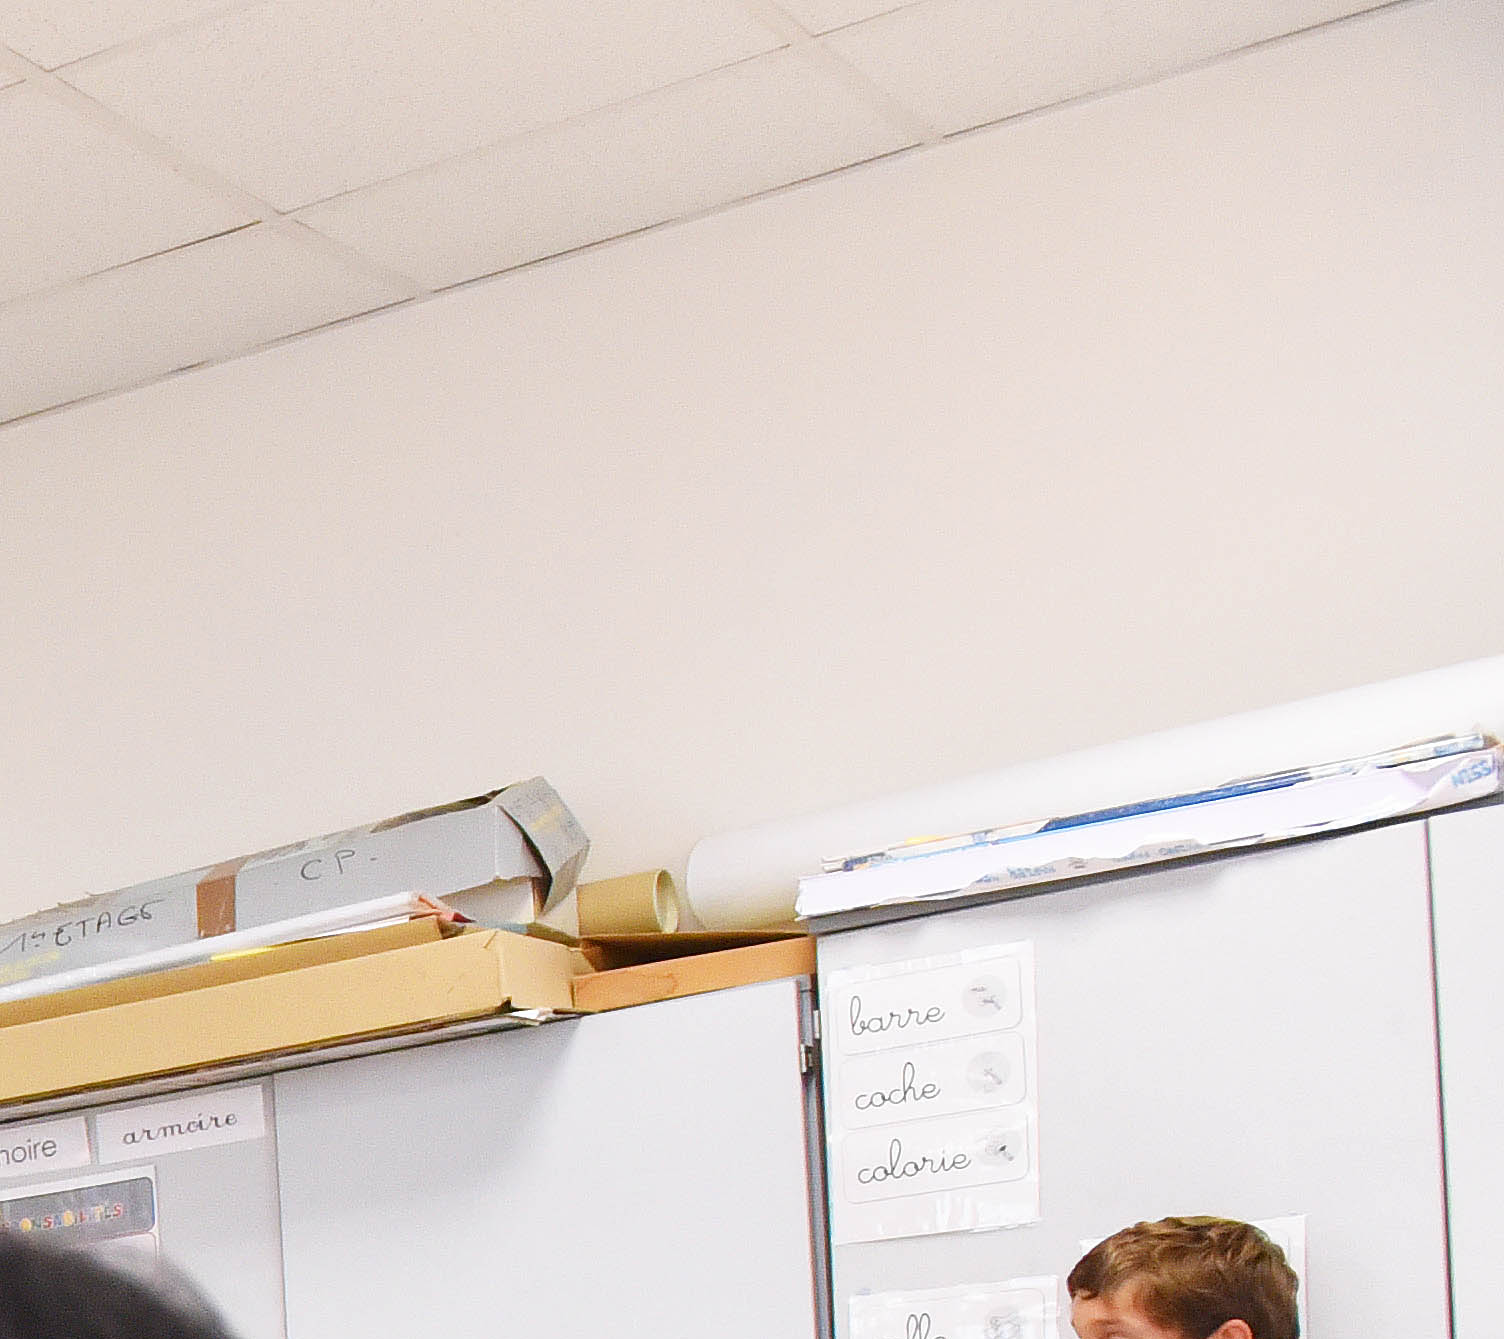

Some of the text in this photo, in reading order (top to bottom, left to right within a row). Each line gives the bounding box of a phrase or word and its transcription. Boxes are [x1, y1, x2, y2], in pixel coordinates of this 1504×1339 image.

[850, 996, 945, 1036] barre
[855, 1062, 941, 1109] coche
[122, 1112, 238, 1145] armoire
[858, 1138, 971, 1184] colorie
